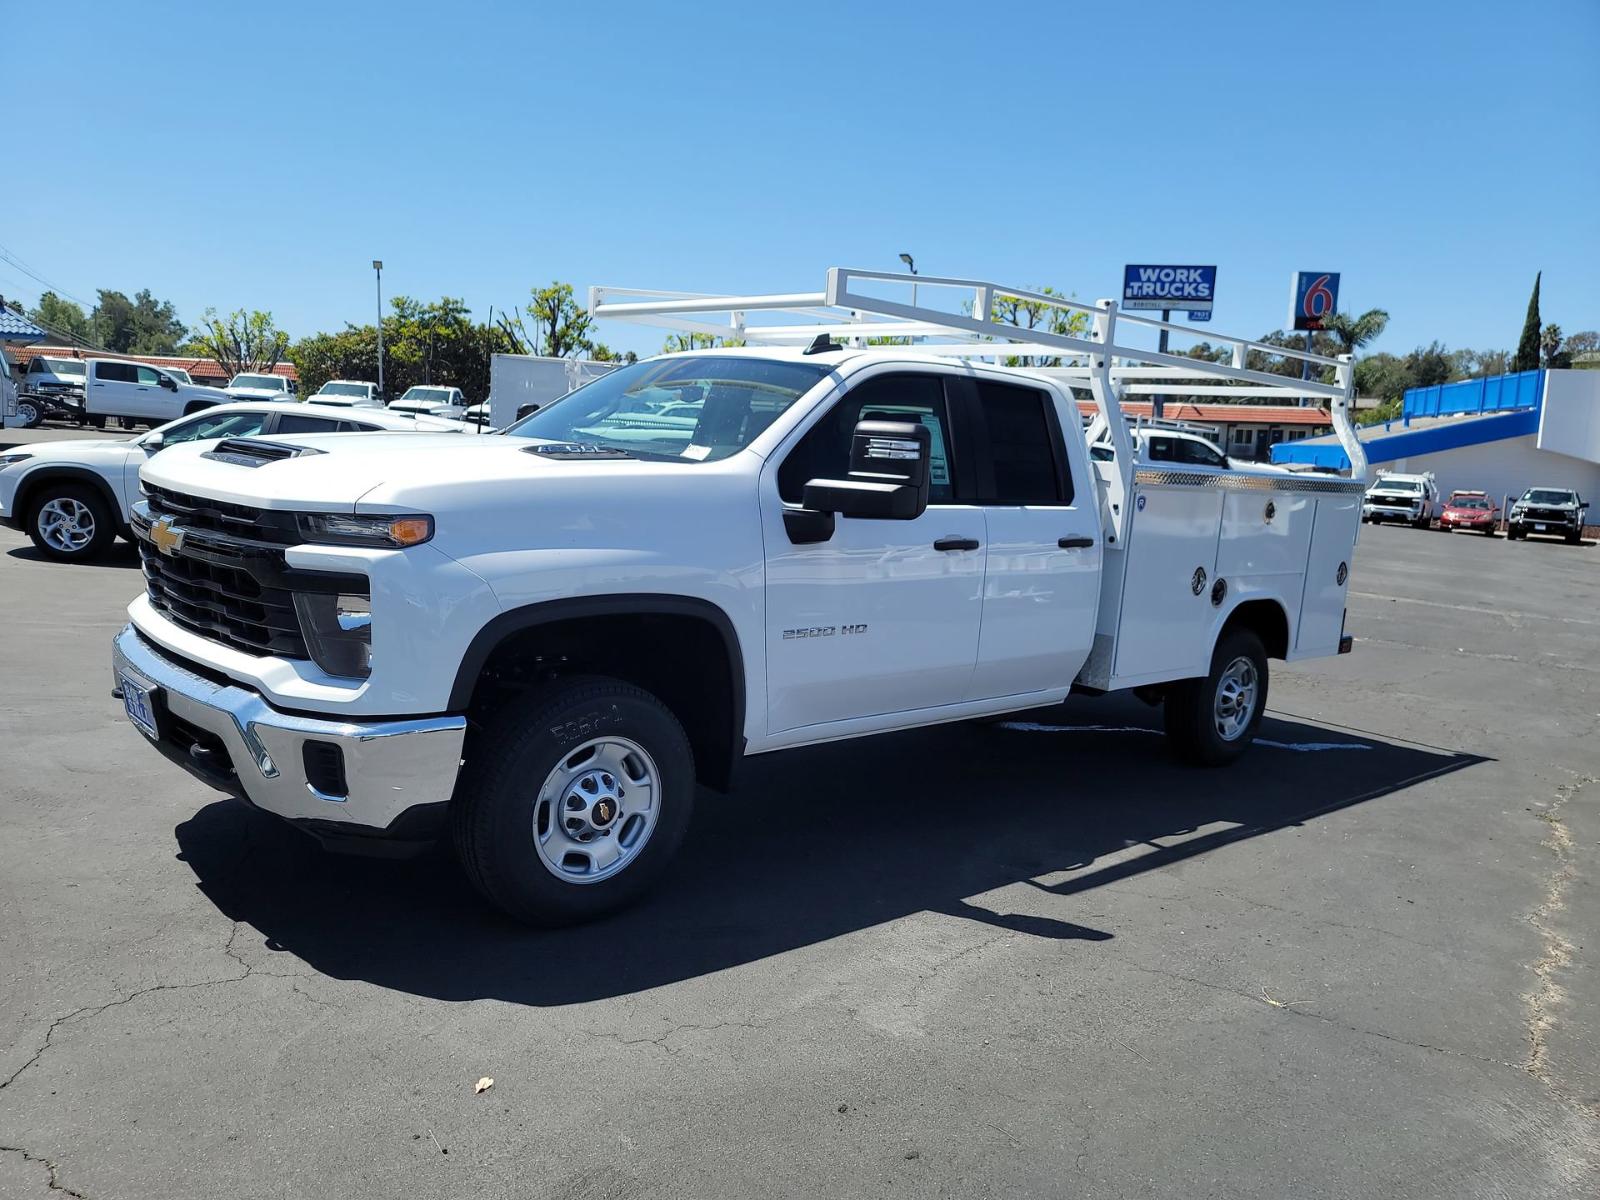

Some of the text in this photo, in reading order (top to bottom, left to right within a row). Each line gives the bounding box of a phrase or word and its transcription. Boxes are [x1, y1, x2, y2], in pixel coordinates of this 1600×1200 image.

[1139, 268, 1203, 283] WORK
[1130, 282, 1210, 297] TRUCKS
[1304, 275, 1333, 318] 6
[782, 624, 867, 639] 2500 HD
